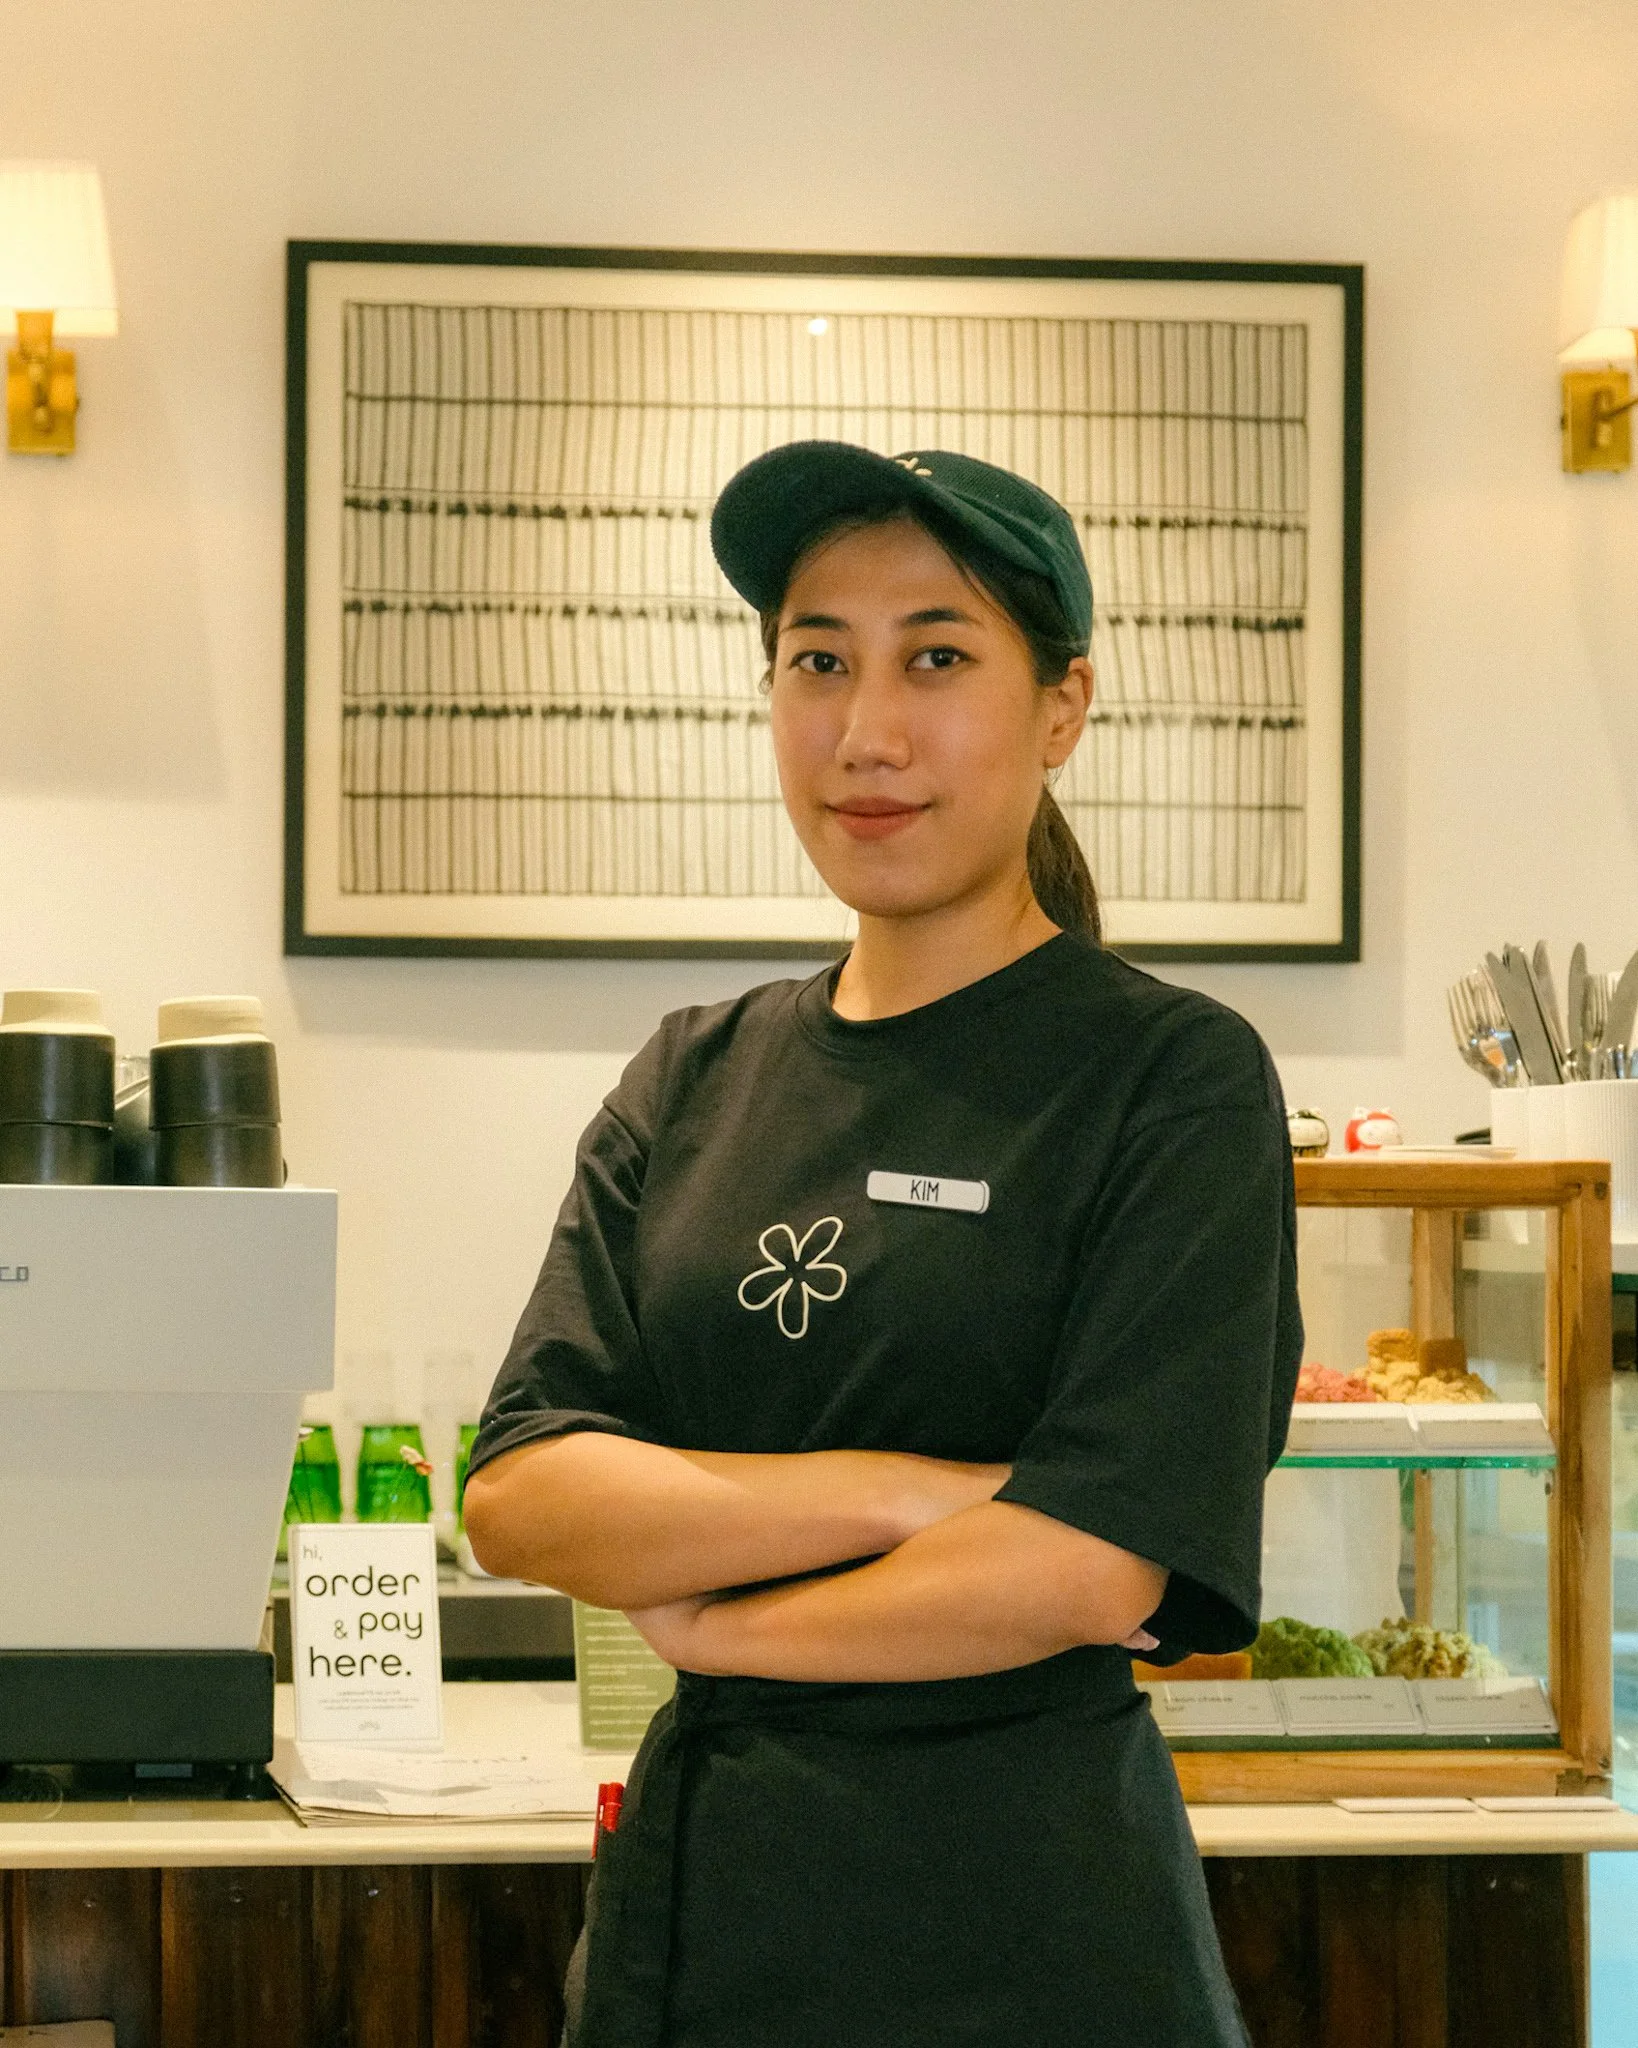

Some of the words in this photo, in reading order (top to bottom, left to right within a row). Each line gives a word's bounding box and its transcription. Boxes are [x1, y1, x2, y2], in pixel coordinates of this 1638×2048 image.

[910, 1179, 940, 1203] KIM
[303, 1545, 323, 1561] hi,
[305, 1565, 420, 1597] order
[334, 1619, 349, 1640] &
[358, 1611, 423, 1641] pay
[309, 1646, 412, 1678] here.
